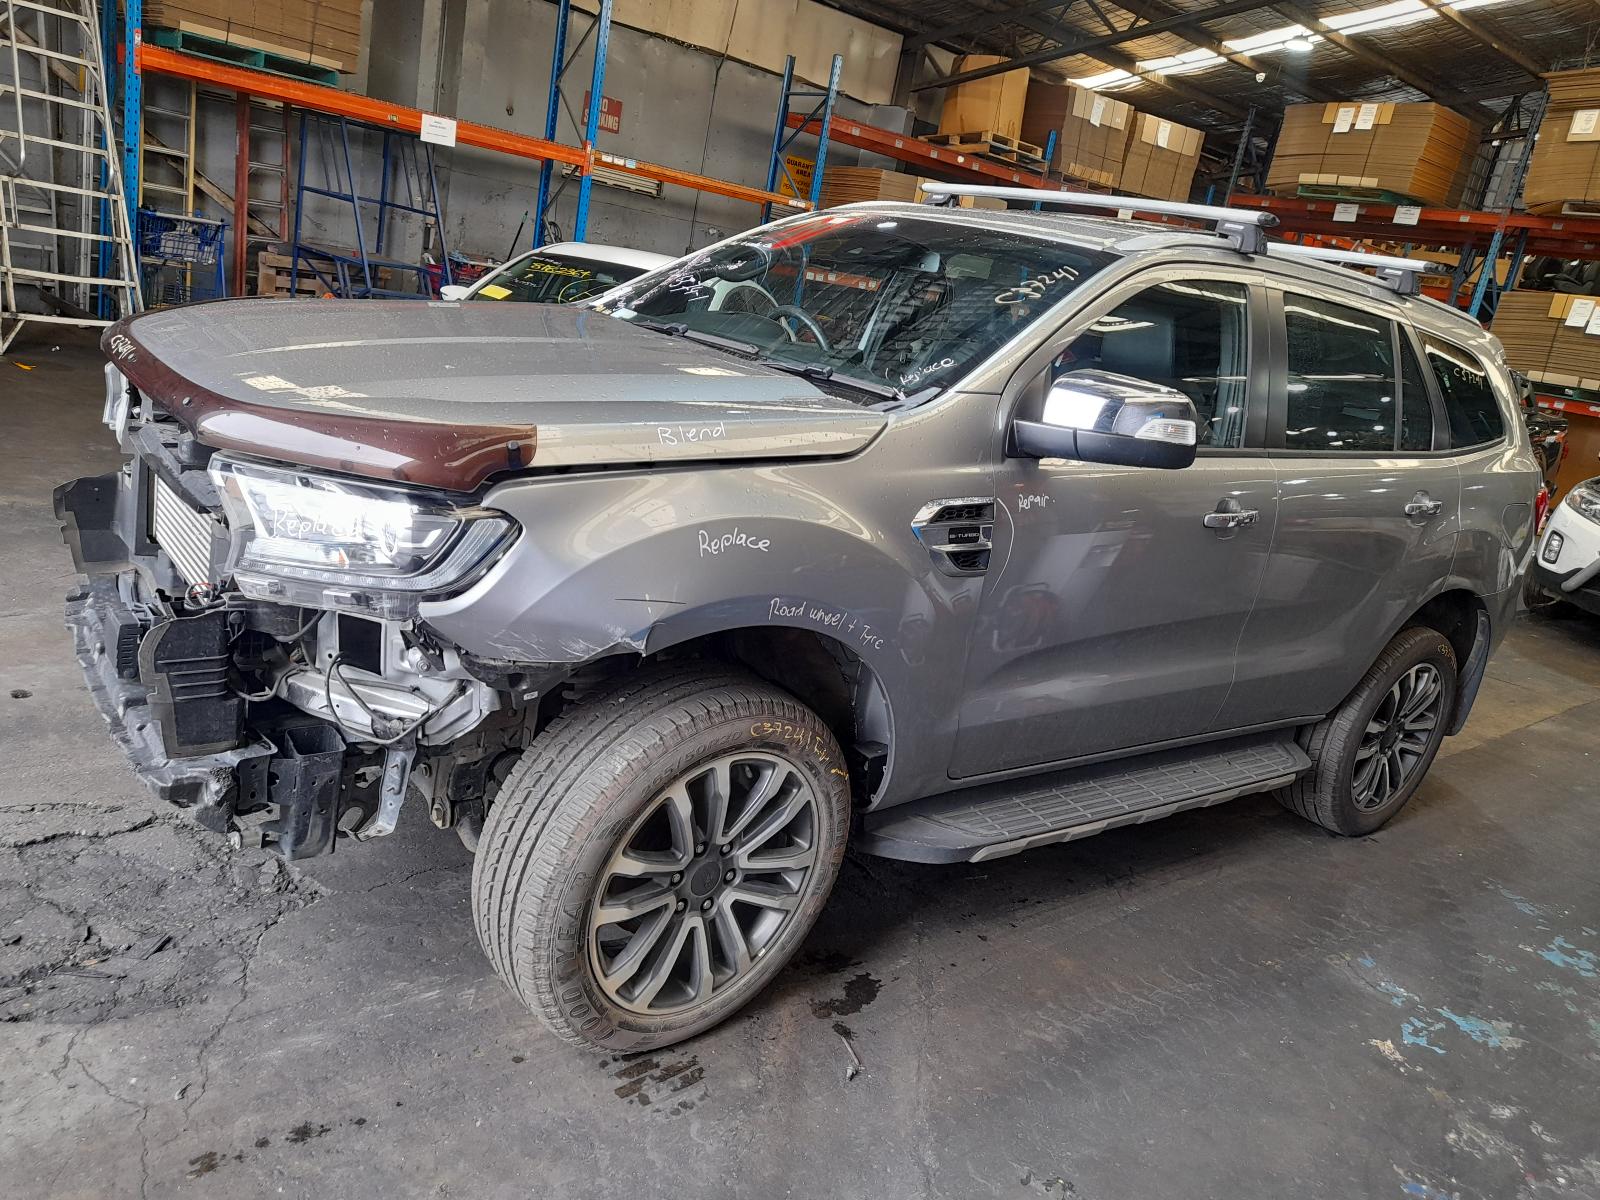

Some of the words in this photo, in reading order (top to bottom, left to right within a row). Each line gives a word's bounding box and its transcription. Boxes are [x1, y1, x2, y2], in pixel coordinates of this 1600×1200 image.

[583, 108, 619, 131] SKING
[786, 156, 814, 171] QUARANT
[657, 421, 726, 446] Blend
[698, 527, 771, 557] Replace
[768, 597, 807, 621] Road
